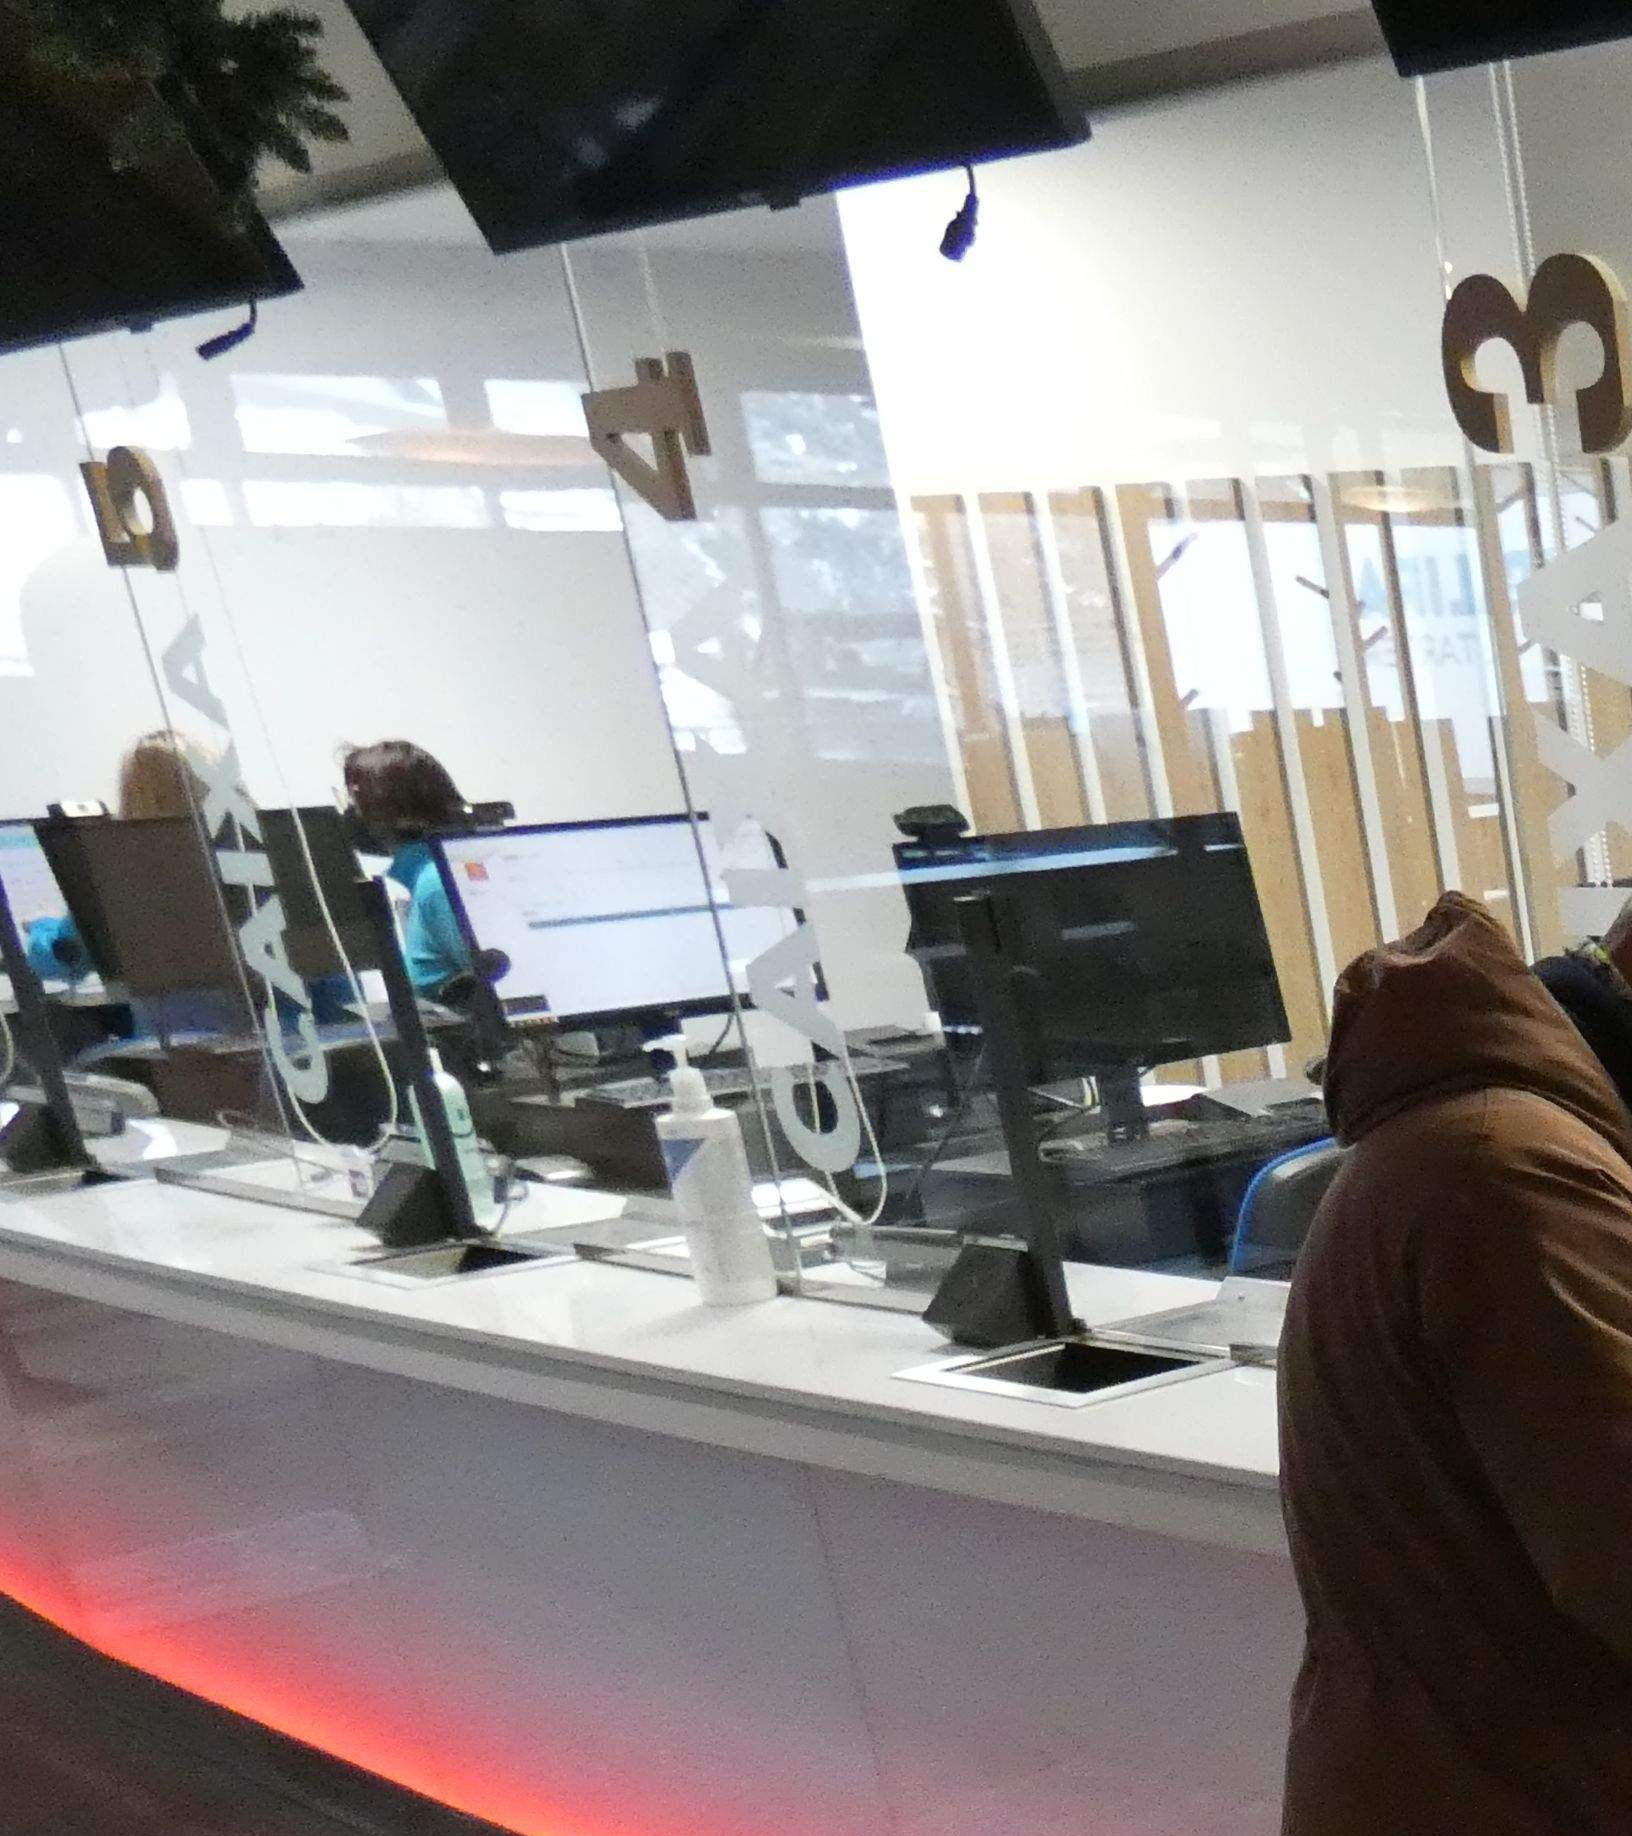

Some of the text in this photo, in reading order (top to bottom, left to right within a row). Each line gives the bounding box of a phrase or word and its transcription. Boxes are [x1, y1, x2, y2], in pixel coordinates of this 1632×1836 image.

[581, 350, 711, 522] 4
[79, 445, 328, 1103] CAIXA 5
